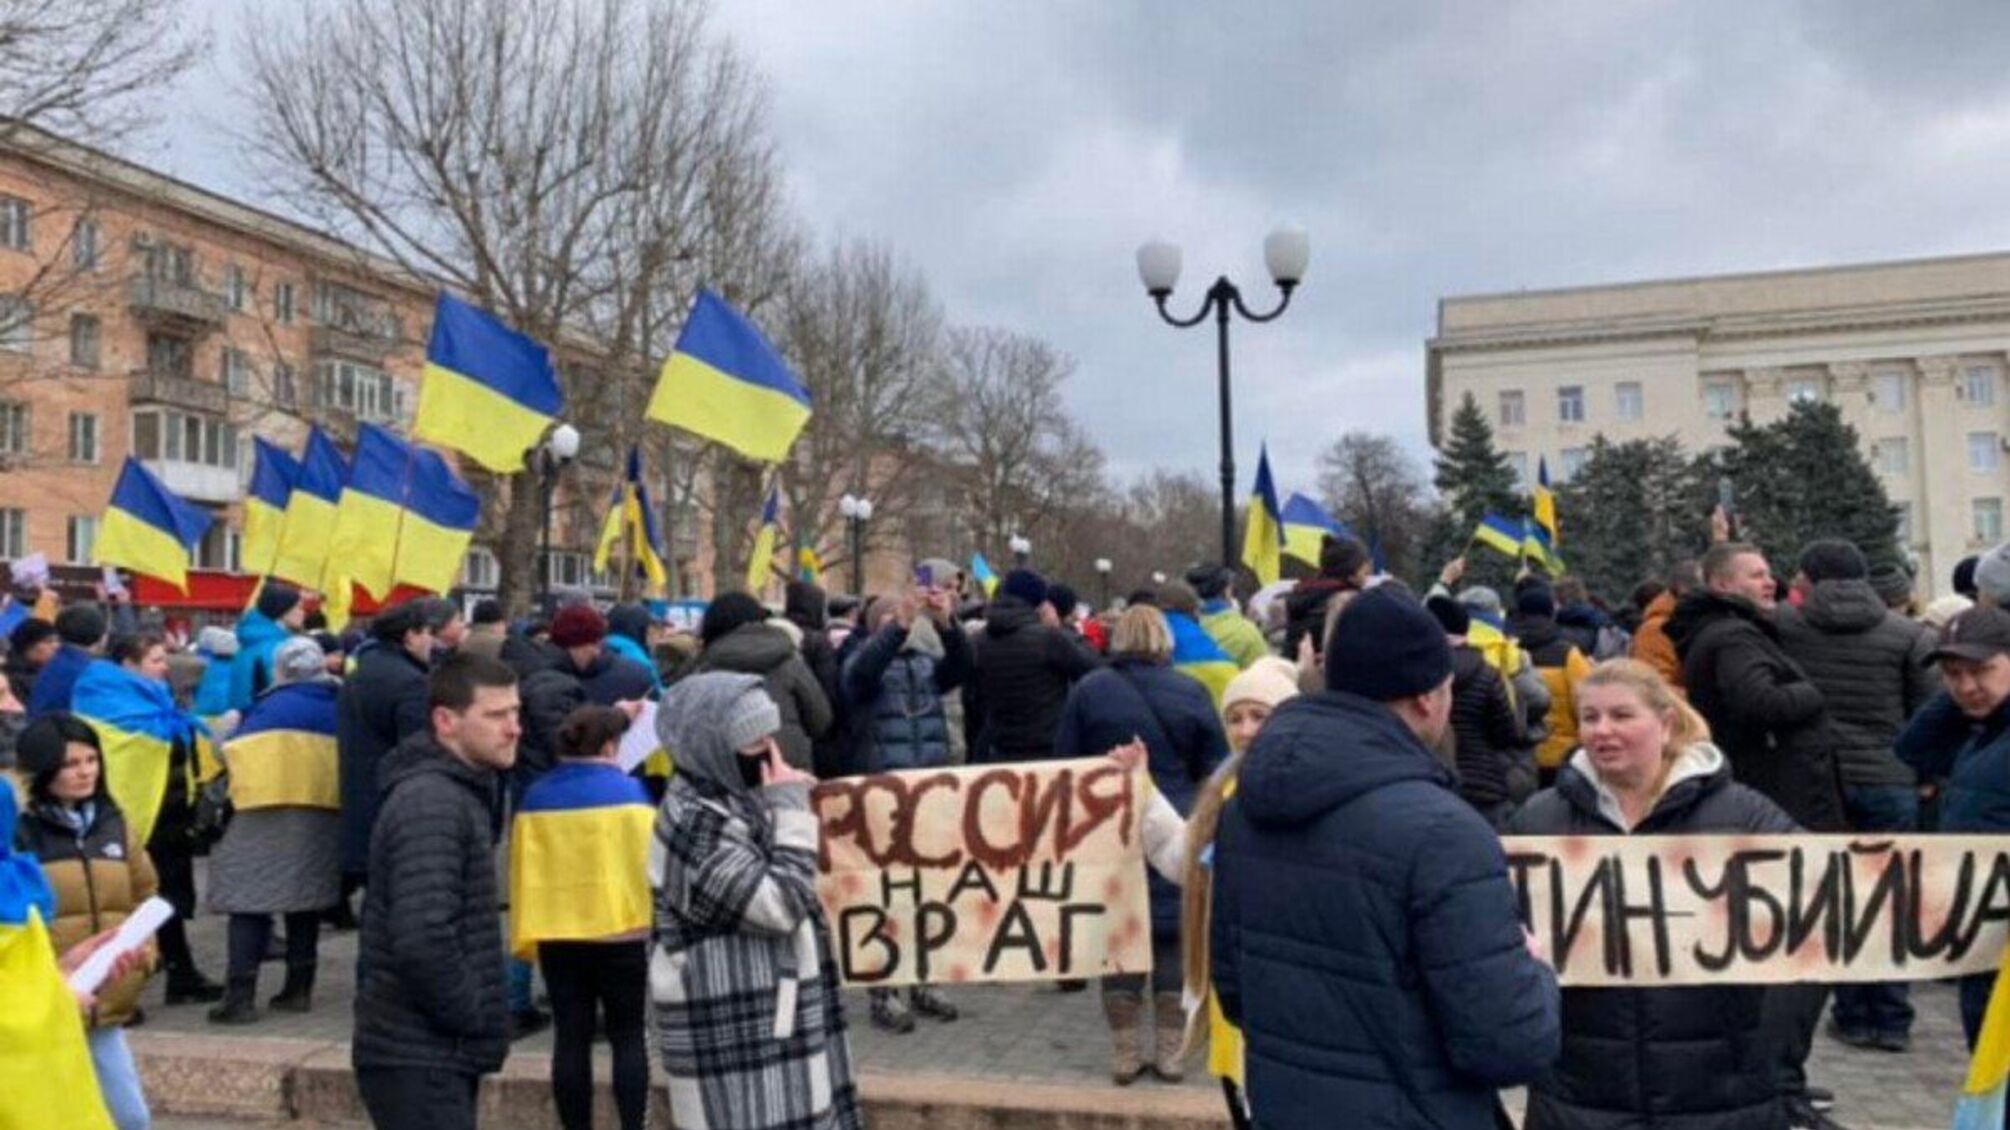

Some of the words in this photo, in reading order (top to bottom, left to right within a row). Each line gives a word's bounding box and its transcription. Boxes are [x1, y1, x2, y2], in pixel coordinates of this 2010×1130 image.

[810, 768, 1133, 873] РОССИЯ
[881, 860, 1073, 908] НАШ
[838, 900, 1106, 982] ВРАГ
